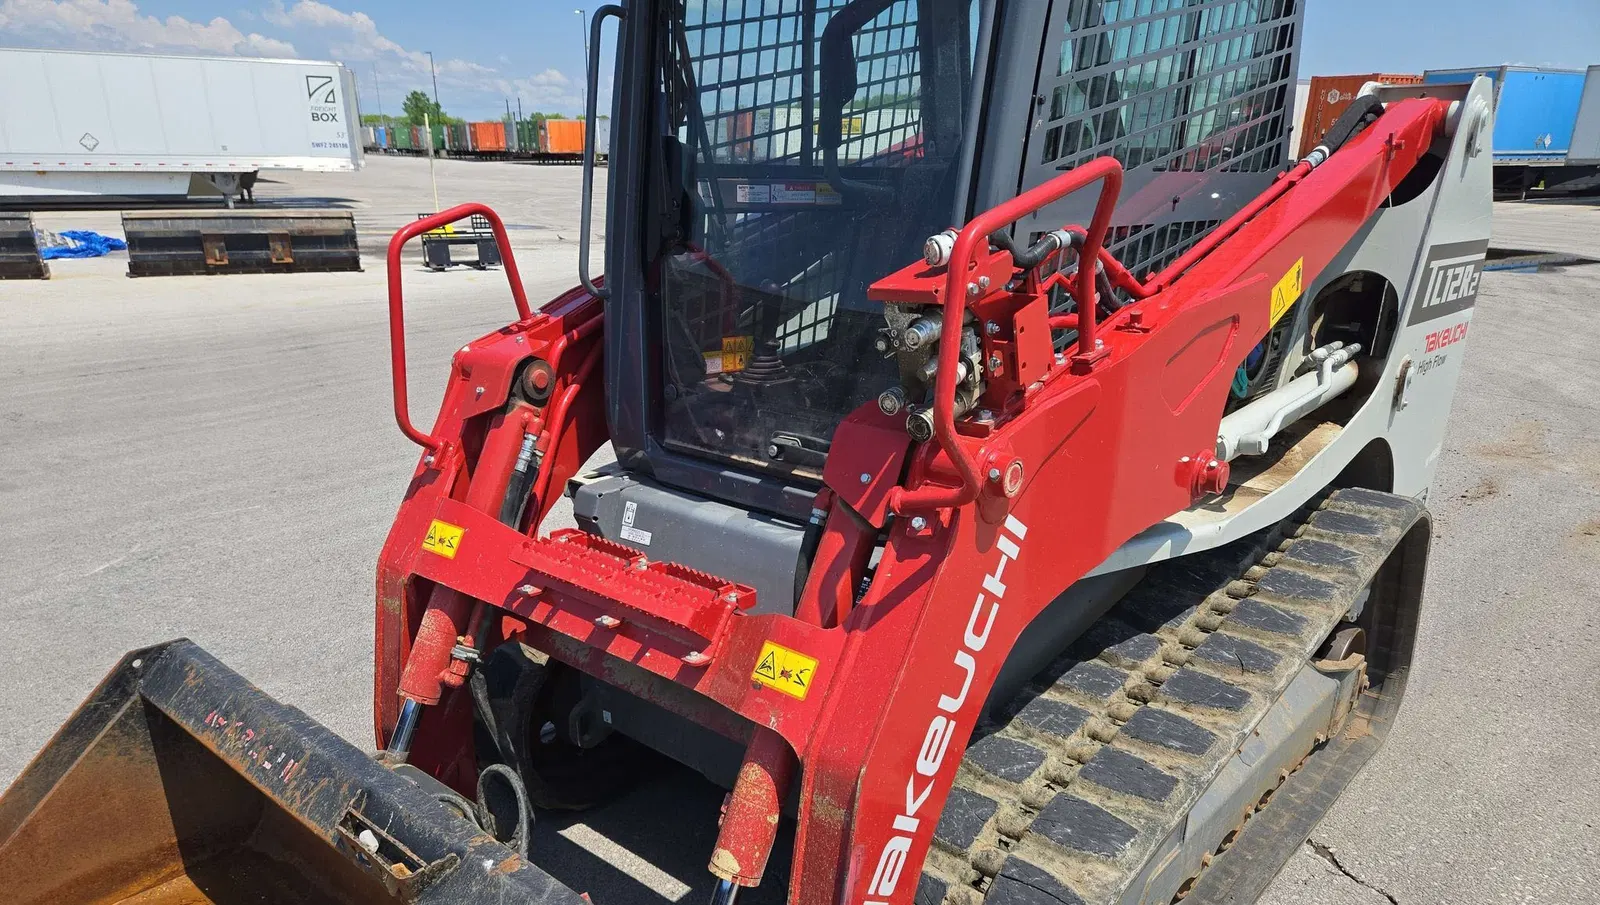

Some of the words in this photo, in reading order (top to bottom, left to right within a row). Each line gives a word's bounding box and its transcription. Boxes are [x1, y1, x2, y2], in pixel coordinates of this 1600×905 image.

[311, 112, 338, 122] BOX
[1417, 357, 1432, 376] High
[1432, 354, 1448, 369] Flow
